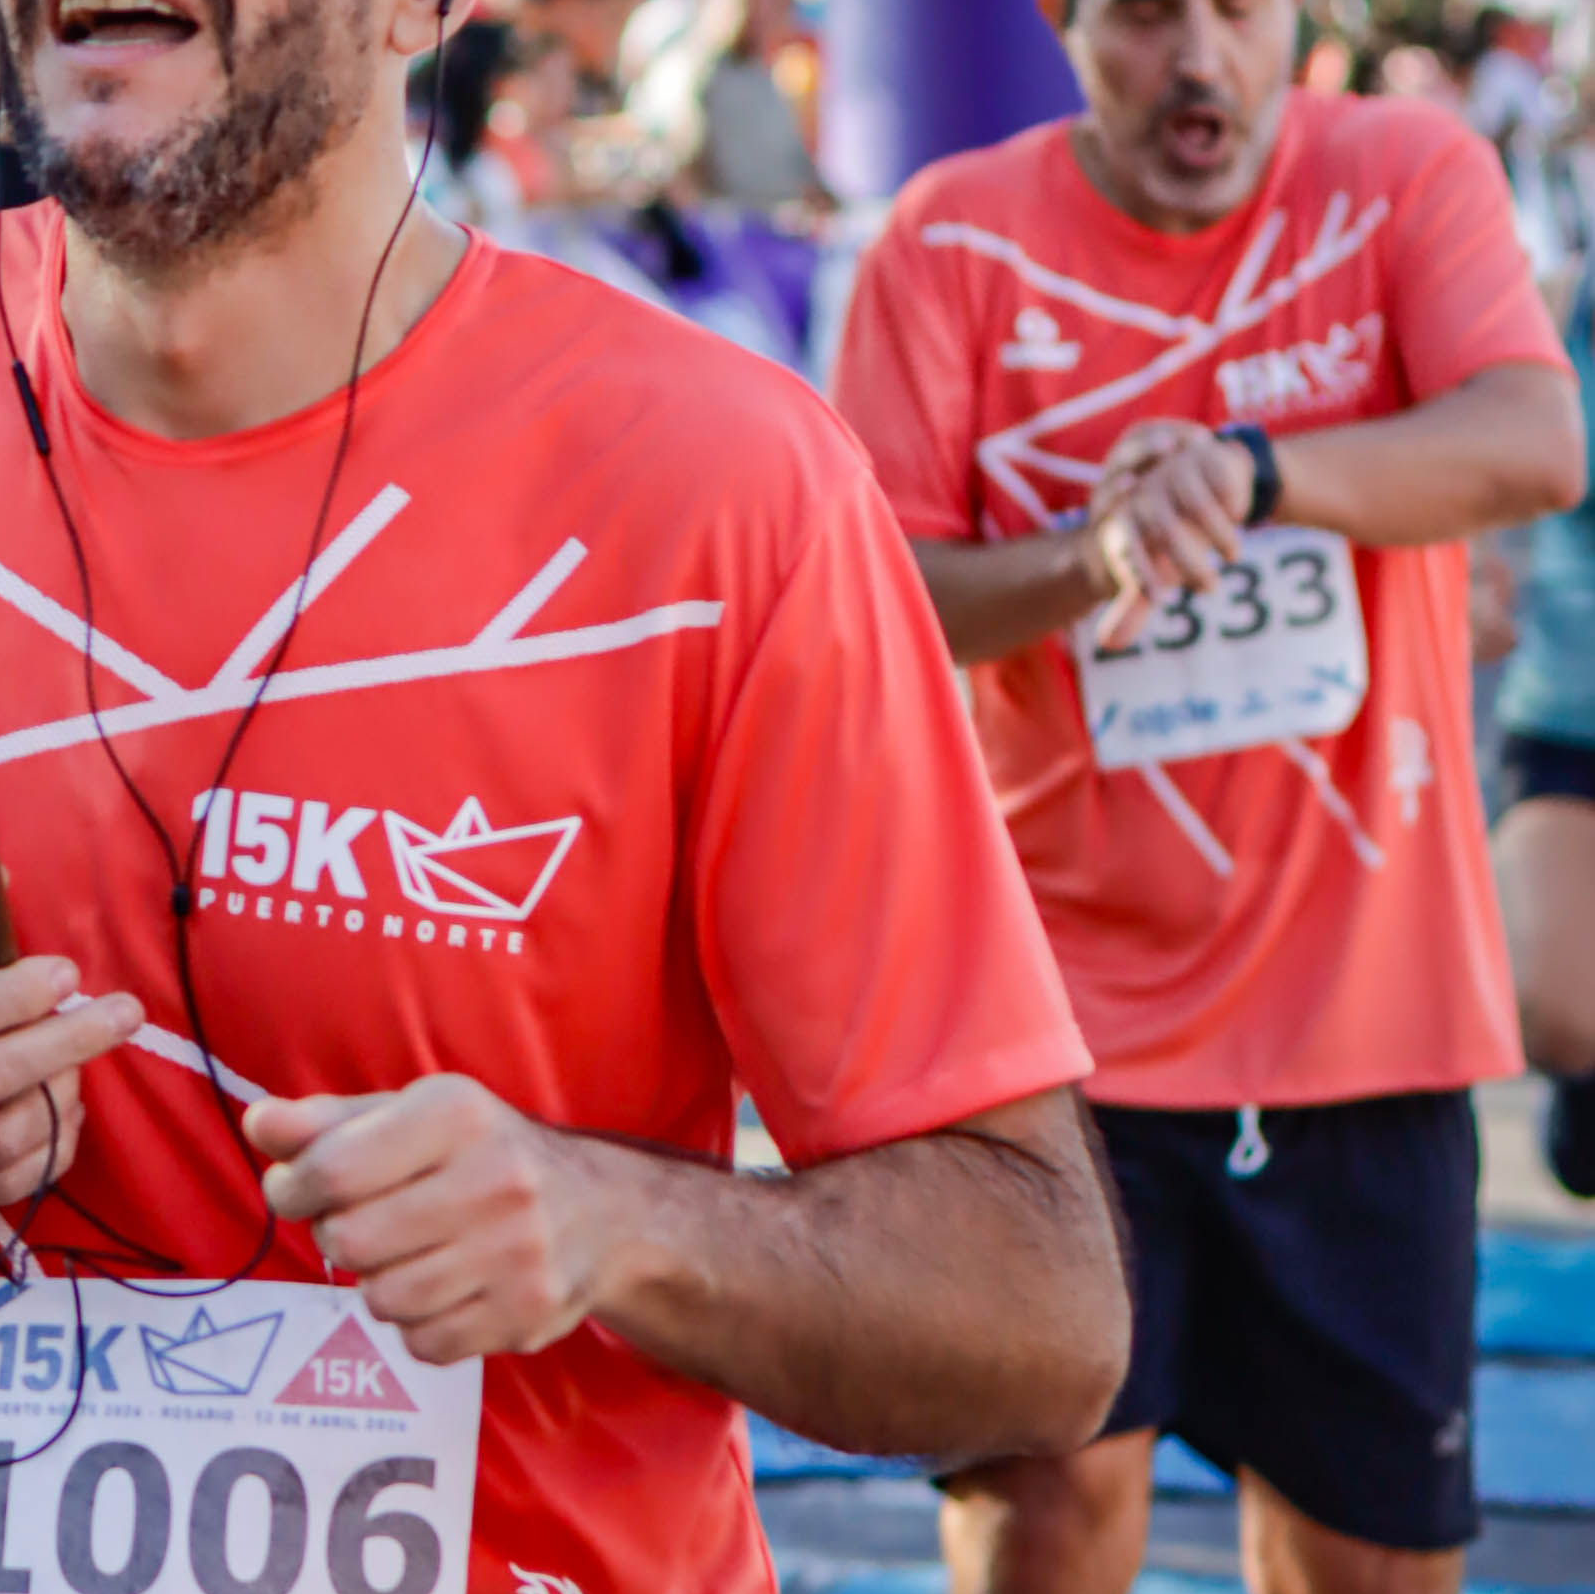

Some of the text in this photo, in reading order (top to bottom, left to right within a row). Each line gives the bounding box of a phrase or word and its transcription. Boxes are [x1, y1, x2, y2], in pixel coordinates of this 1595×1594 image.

[1094, 547, 1338, 663] 333
[191, 787, 377, 900] 15K
[198, 887, 524, 955] PUERTO NORTE
[309, 1356, 386, 1398] 15K
